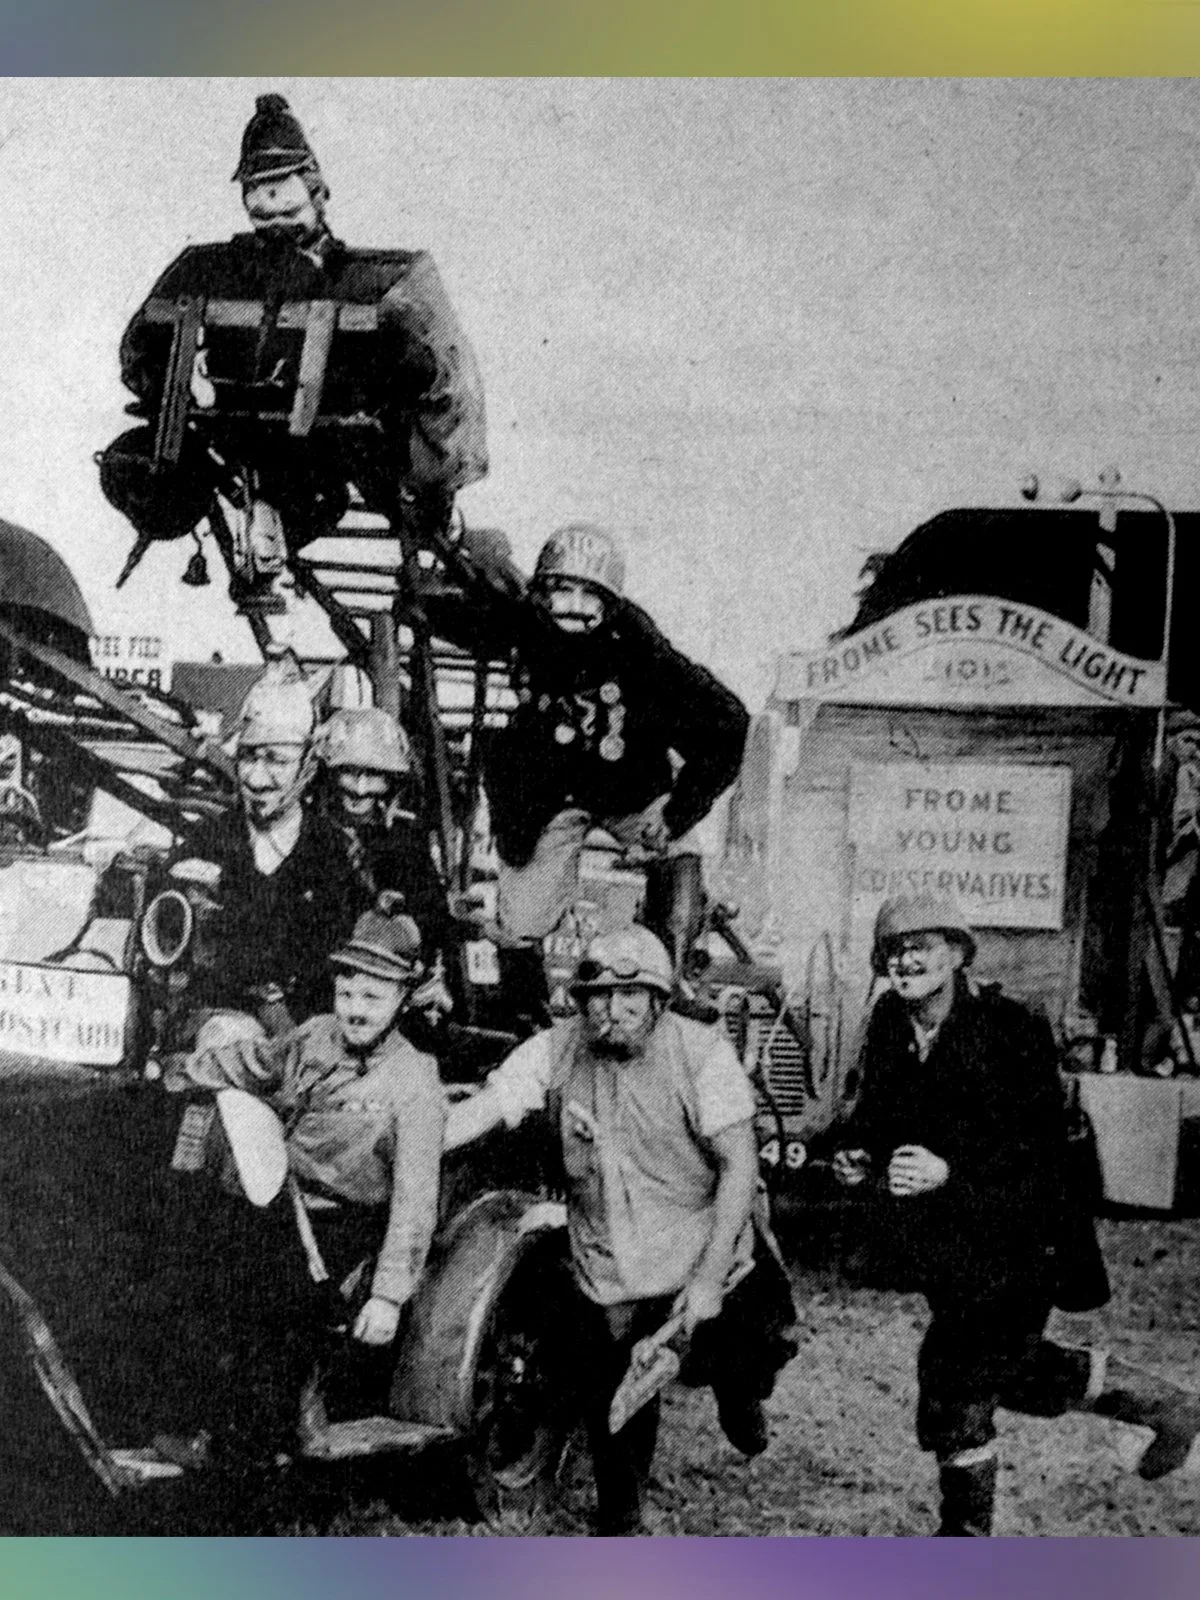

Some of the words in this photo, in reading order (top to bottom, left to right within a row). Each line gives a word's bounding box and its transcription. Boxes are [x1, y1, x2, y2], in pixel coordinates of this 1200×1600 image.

[805, 626, 900, 688] FROME
[915, 604, 982, 639] SEES
[999, 606, 1054, 651] THE
[1059, 637, 1147, 696] LIGHT
[905, 788, 1013, 815] FROME
[900, 830, 1014, 856] YOUNG
